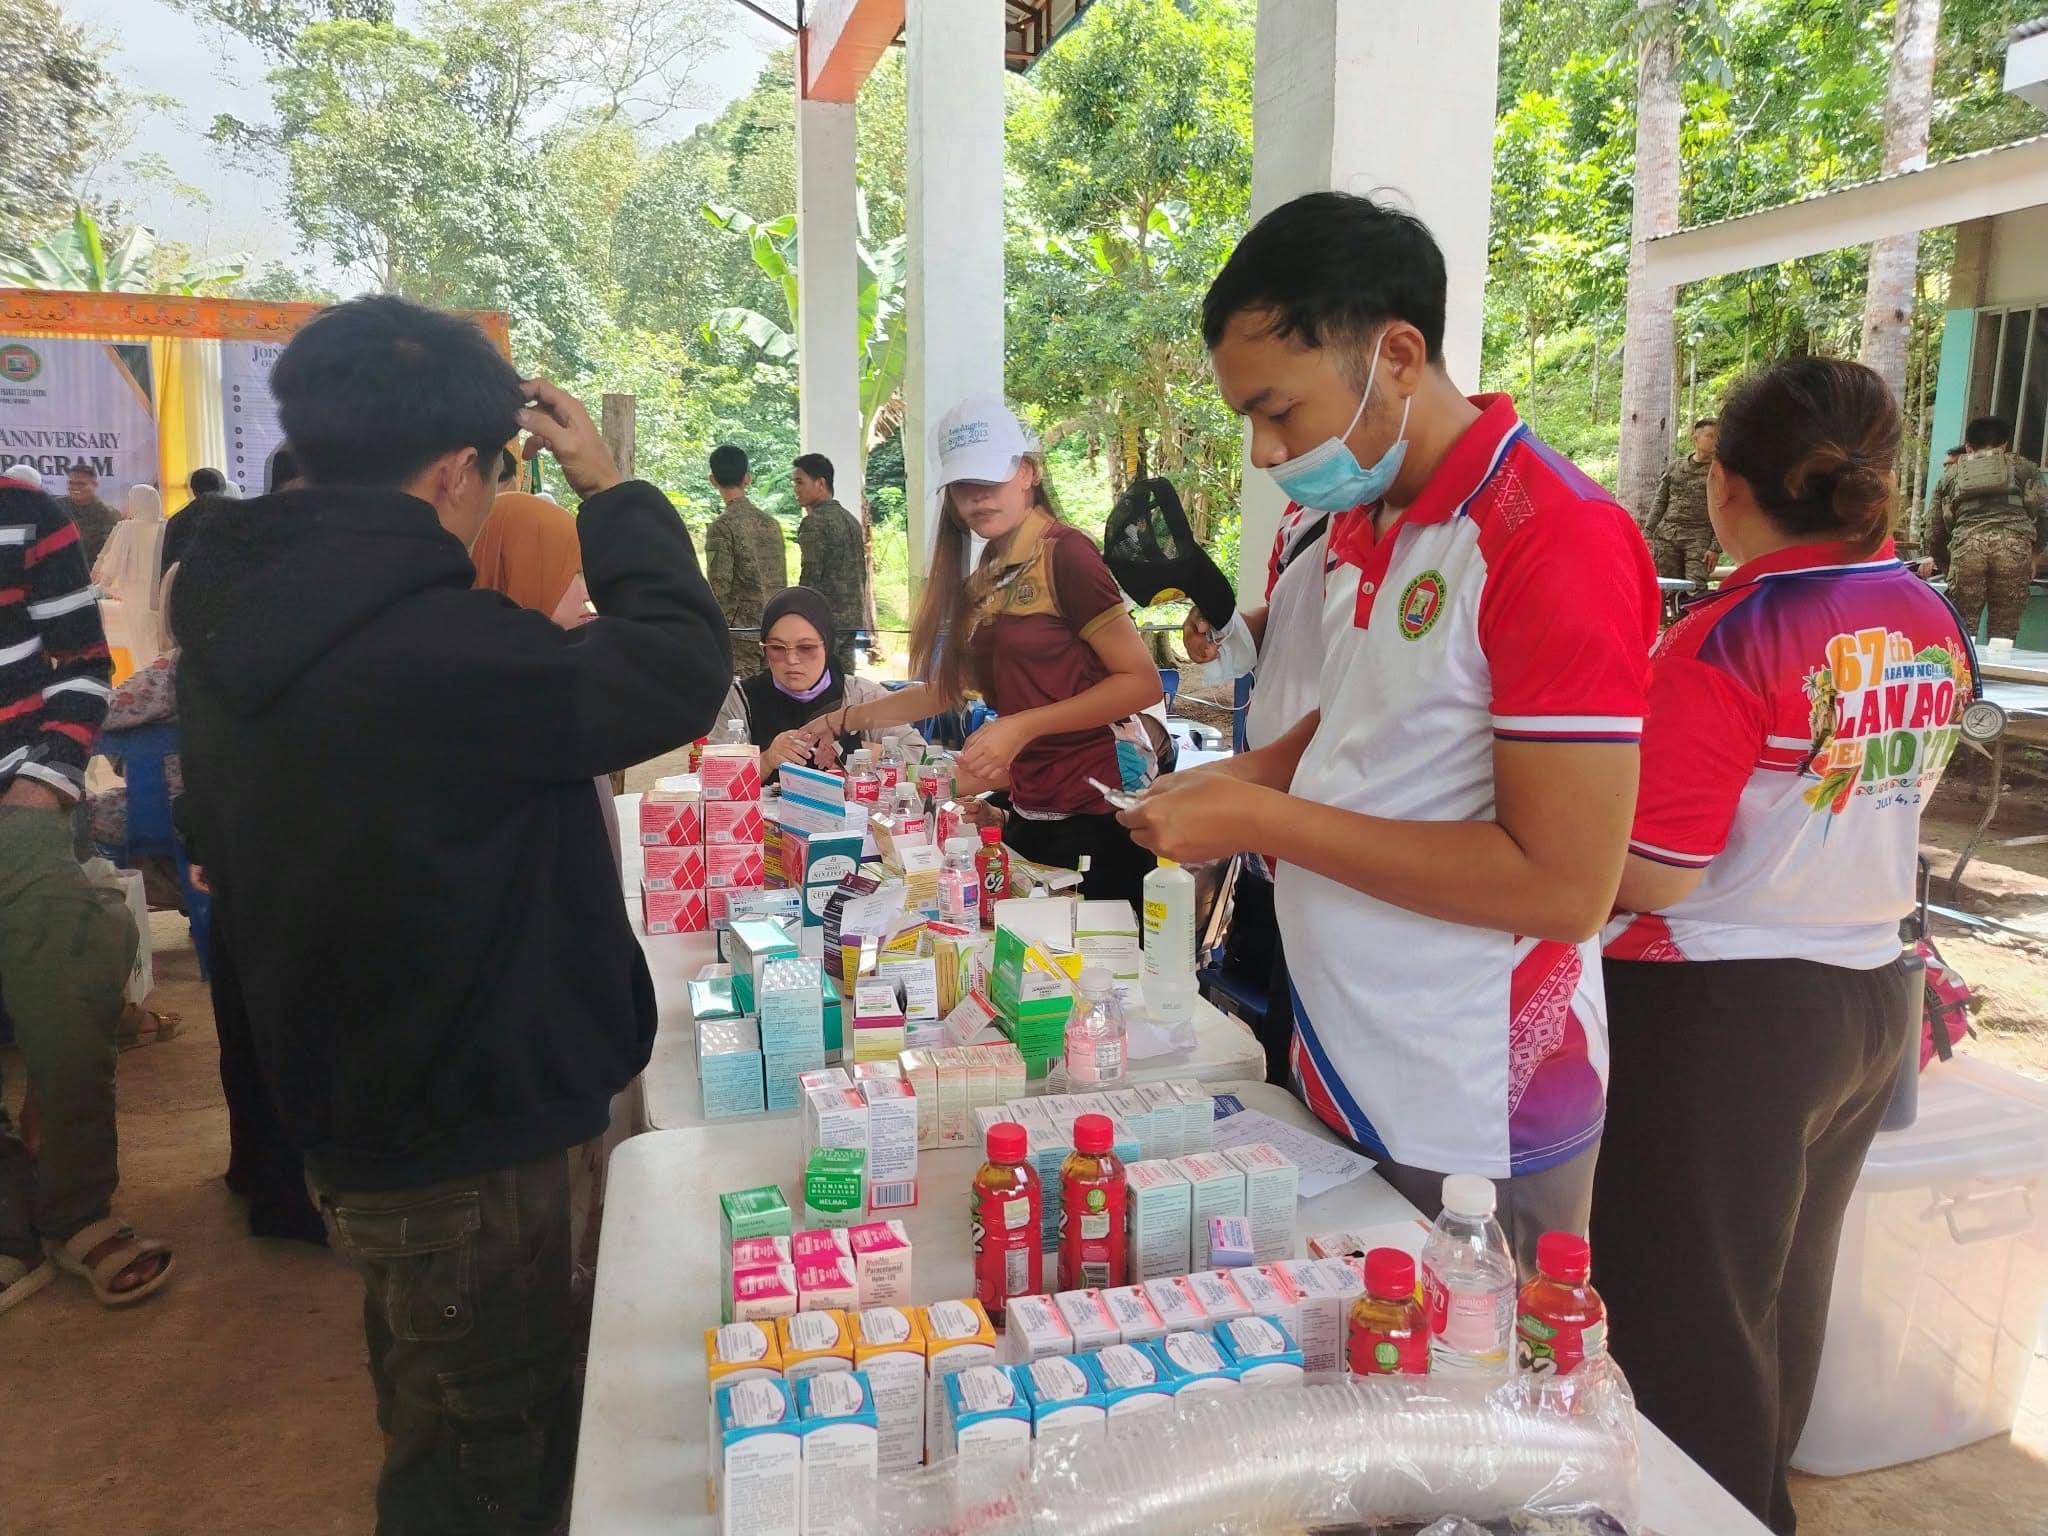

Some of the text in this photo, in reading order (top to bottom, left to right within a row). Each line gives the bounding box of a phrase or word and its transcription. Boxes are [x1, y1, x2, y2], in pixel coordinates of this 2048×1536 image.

[0, 428, 120, 449] ANNIVERSARY
[0, 454, 115, 477] ROGRAM
[1834, 680, 1954, 740] LANAO
